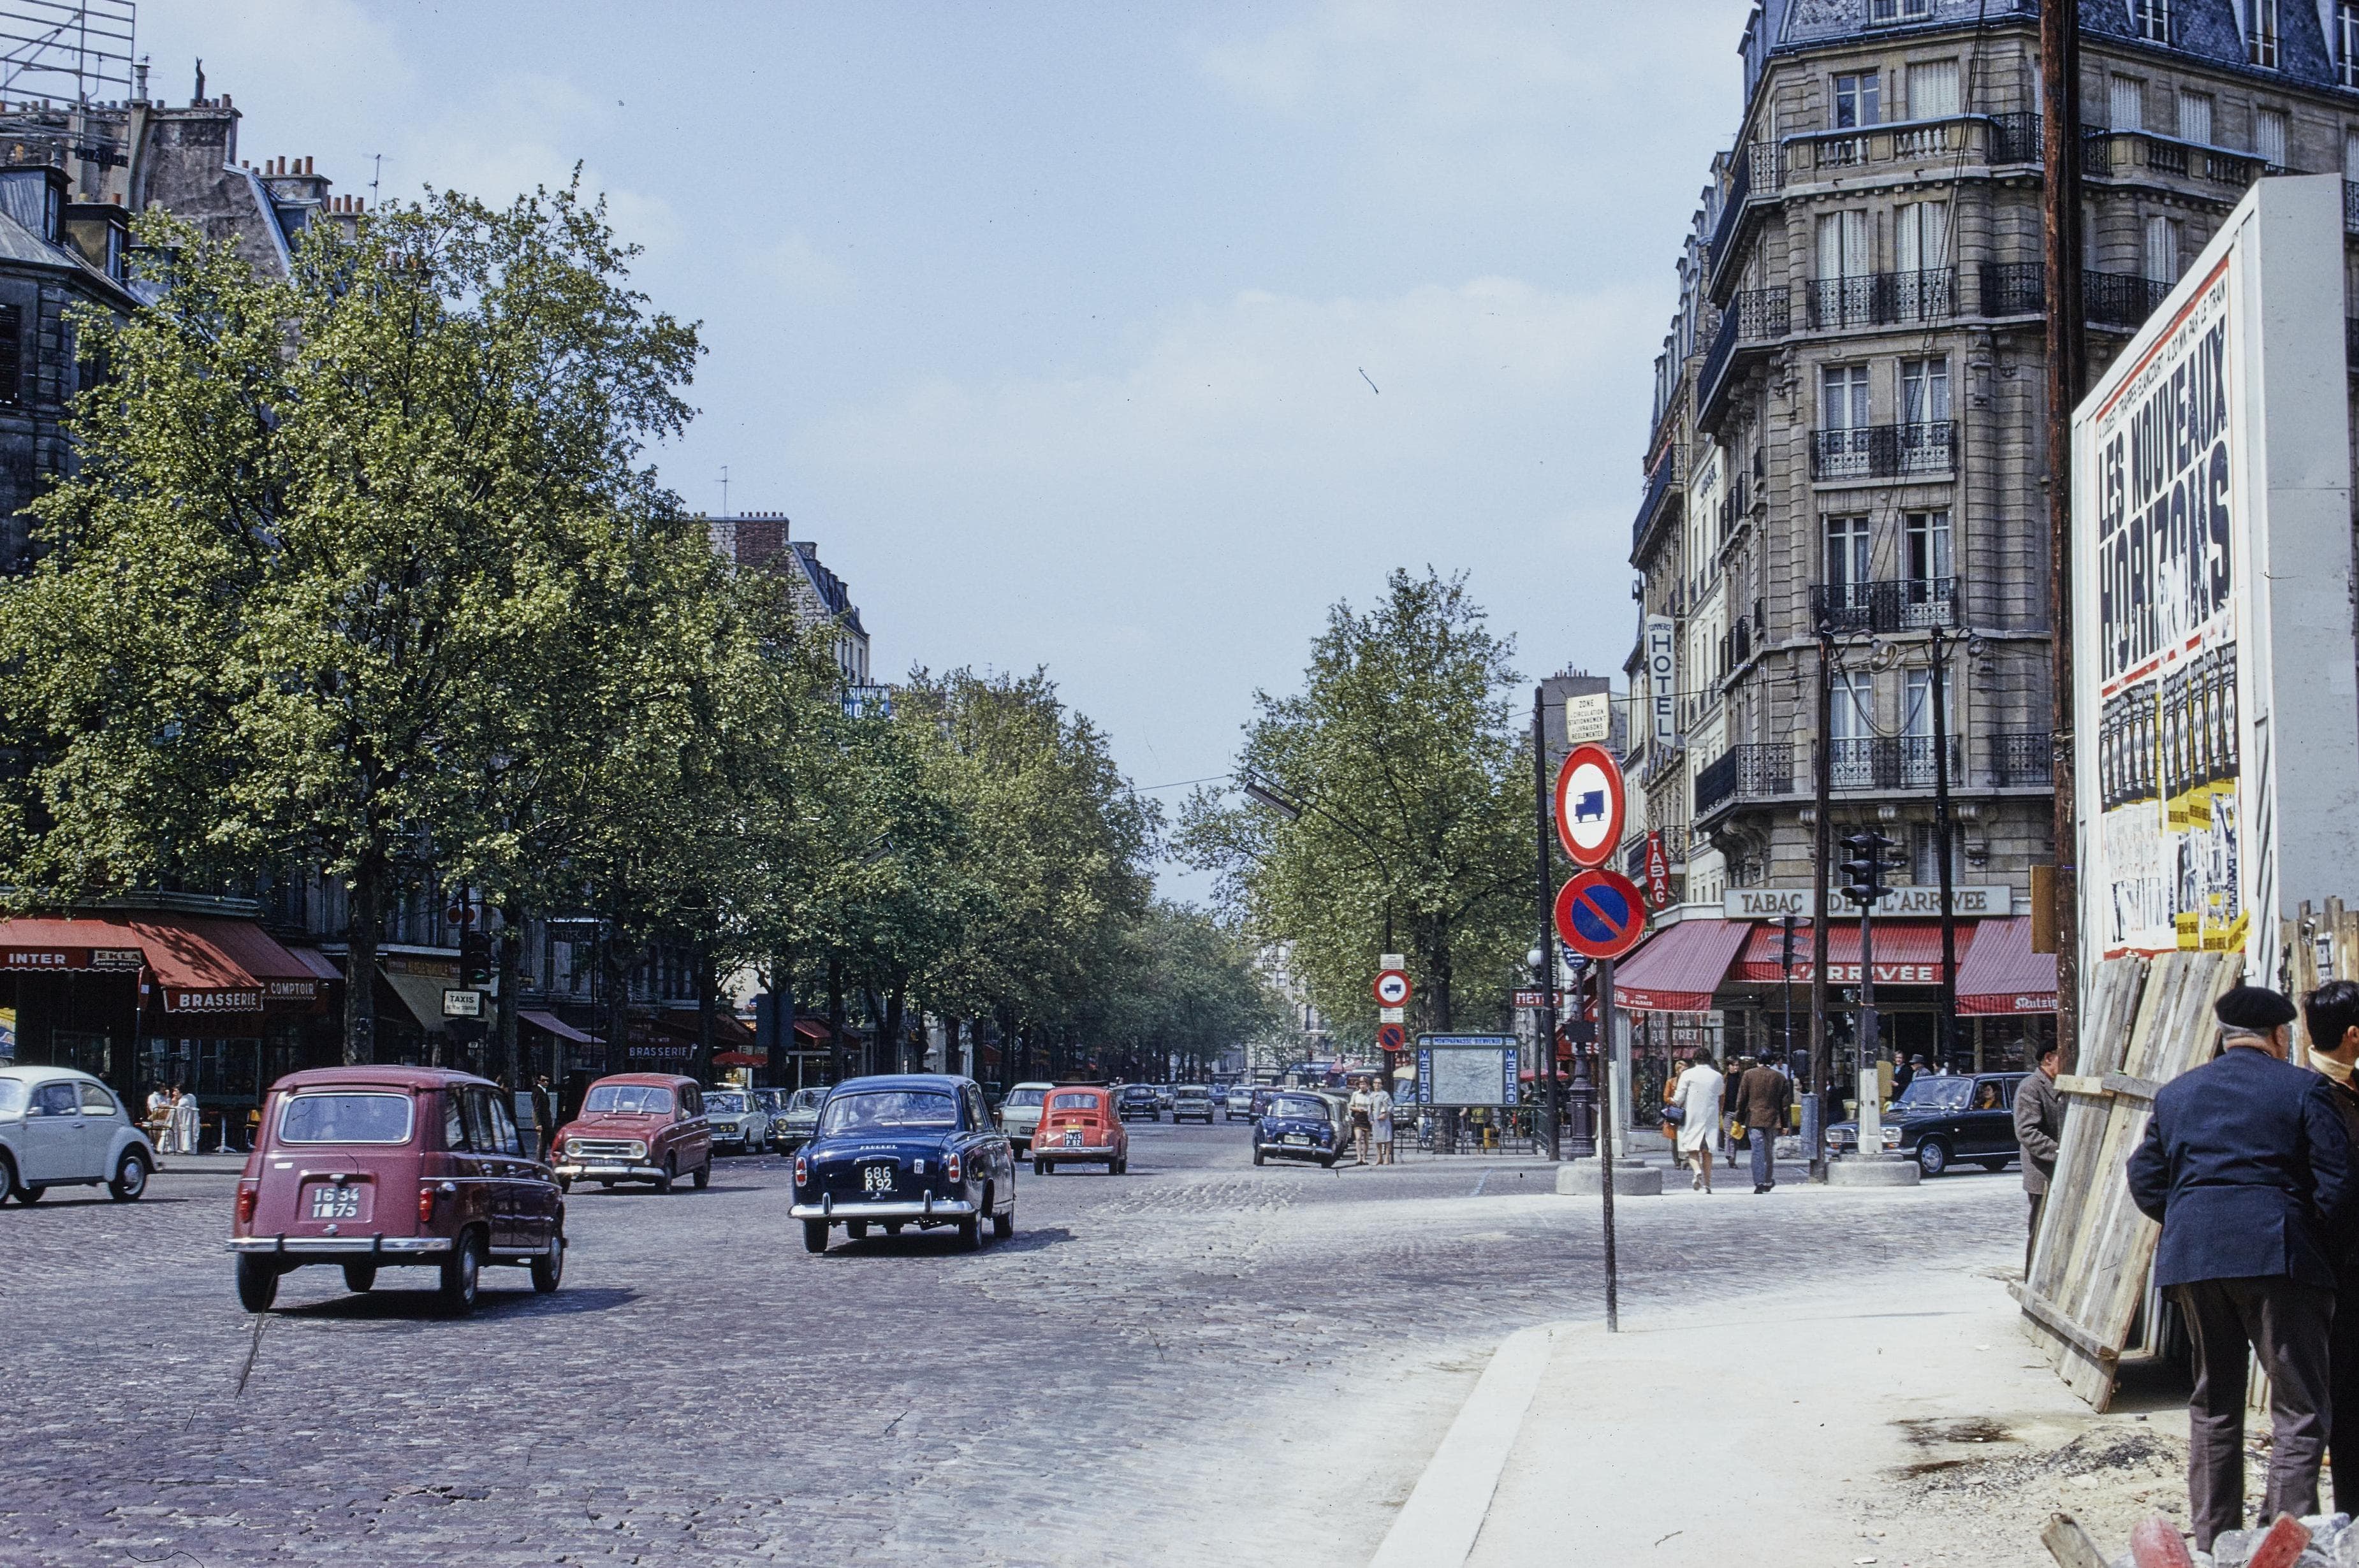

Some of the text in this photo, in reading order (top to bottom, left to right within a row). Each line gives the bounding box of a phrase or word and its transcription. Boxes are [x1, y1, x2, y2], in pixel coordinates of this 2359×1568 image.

[2201, 298, 2207, 326] LE
[2209, 277, 2225, 314] TRAIN
[2099, 314, 2229, 544] LES NOUVEAUX
[2100, 440, 2231, 681] HORIZONS
[1652, 635, 1672, 736] HOTEL
[1579, 699, 1594, 708] ZONE
[1650, 839, 1665, 903] TABAC
[1741, 890, 1987, 913] TABAC DE L'ARRVEE
[9, 954, 66, 964] INTER
[271, 982, 314, 995] COMPTOIR
[1517, 992, 1559, 1004] METO
[179, 992, 256, 1007] BRASSERIE
[629, 1047, 687, 1056] BRASSERIE
[1420, 1050, 1429, 1103] METRO
[1507, 1050, 1515, 1103] METRO
[865, 1166, 891, 1179] 686
[866, 1178, 893, 1191] R 92
